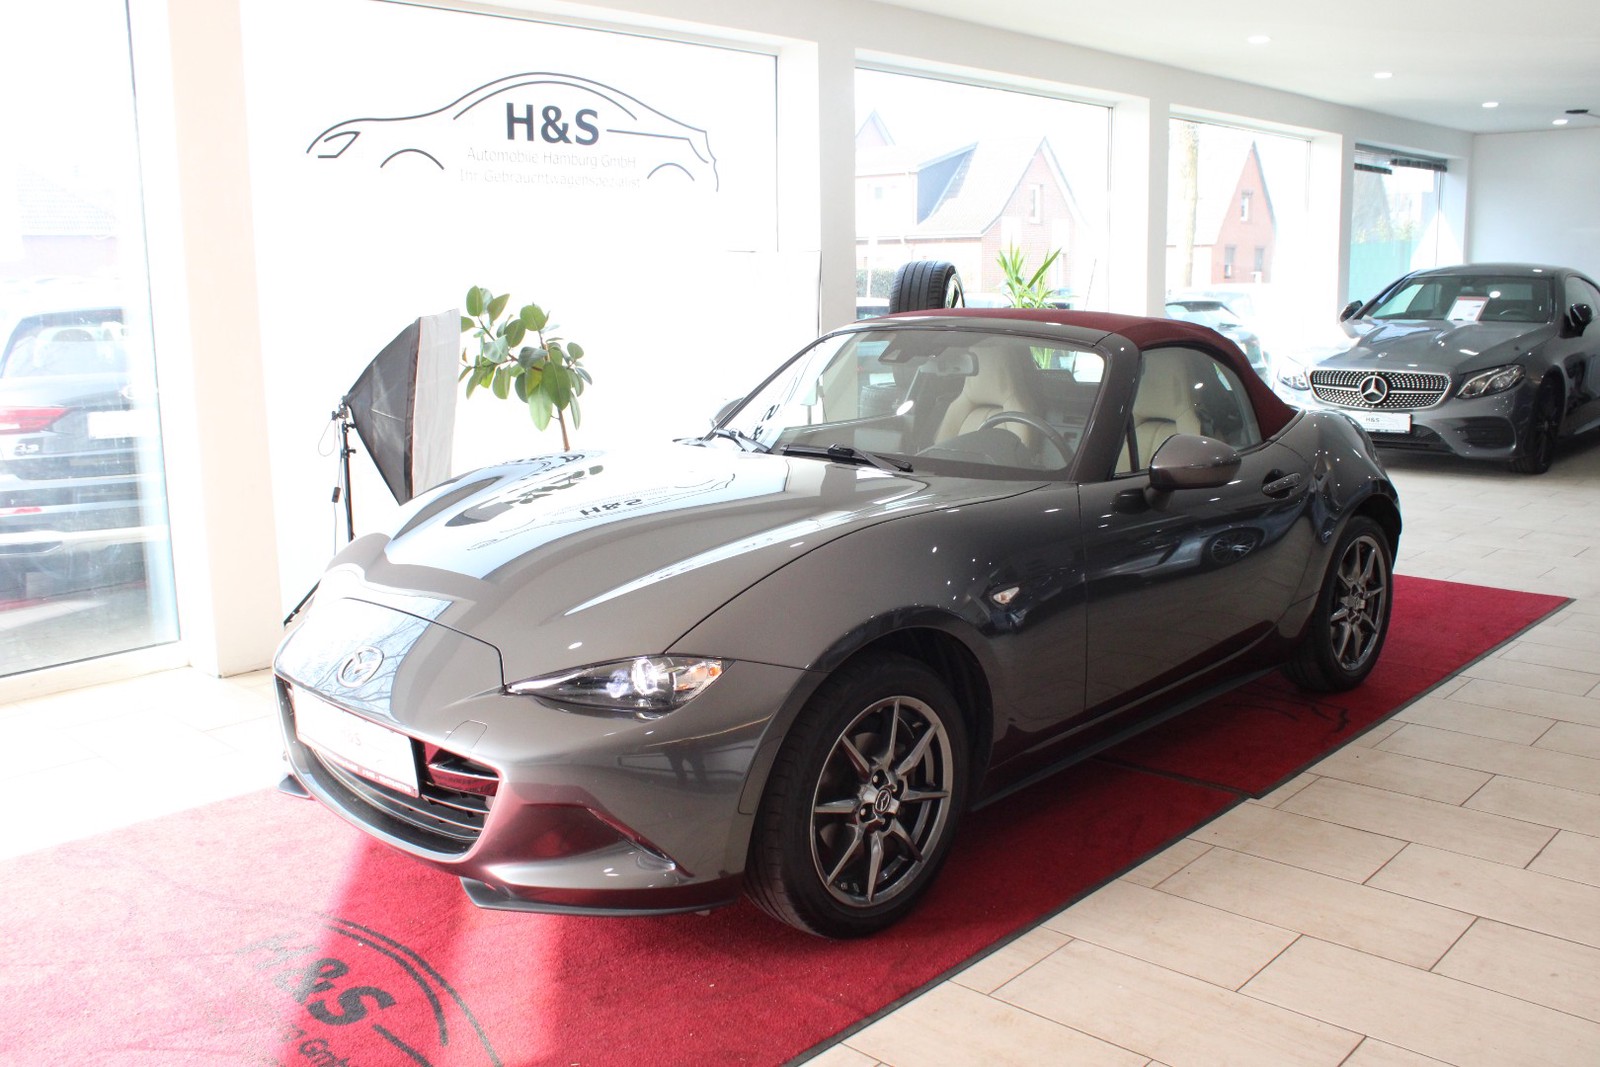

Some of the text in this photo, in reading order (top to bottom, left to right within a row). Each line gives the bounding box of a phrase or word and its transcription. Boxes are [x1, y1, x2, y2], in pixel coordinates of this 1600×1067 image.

[506, 102, 600, 146] H&S
[467, 146, 637, 170] Automobile Hamburg GmbH
[458, 168, 479, 182] Ihr
